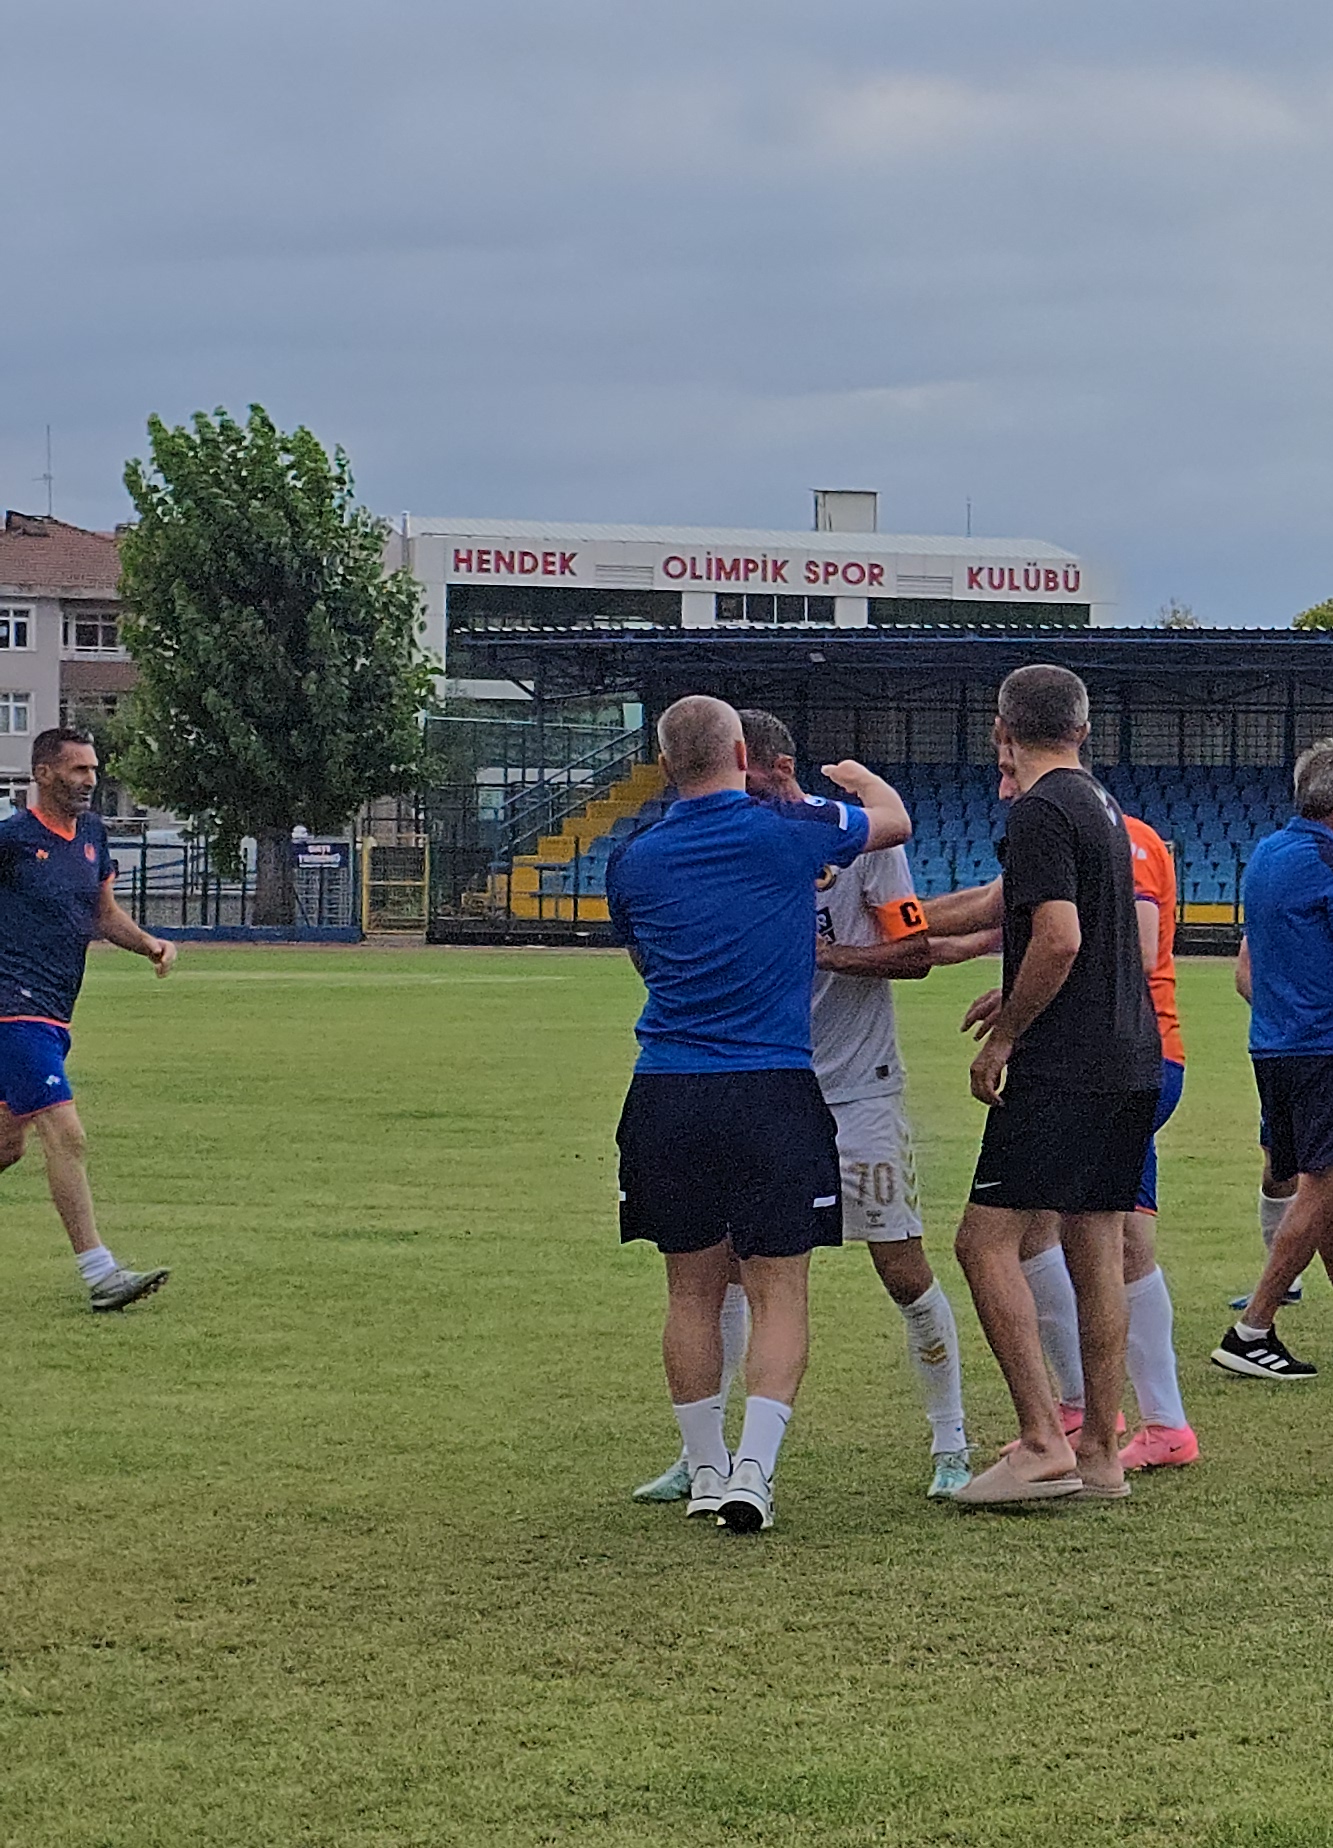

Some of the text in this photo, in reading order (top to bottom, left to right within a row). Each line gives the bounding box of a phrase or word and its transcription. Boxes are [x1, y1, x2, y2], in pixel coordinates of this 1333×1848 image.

[453, 549, 1080, 592] HENDEK OLİMPİK SPOR KULÜBÜ
[899, 902, 922, 928] C
